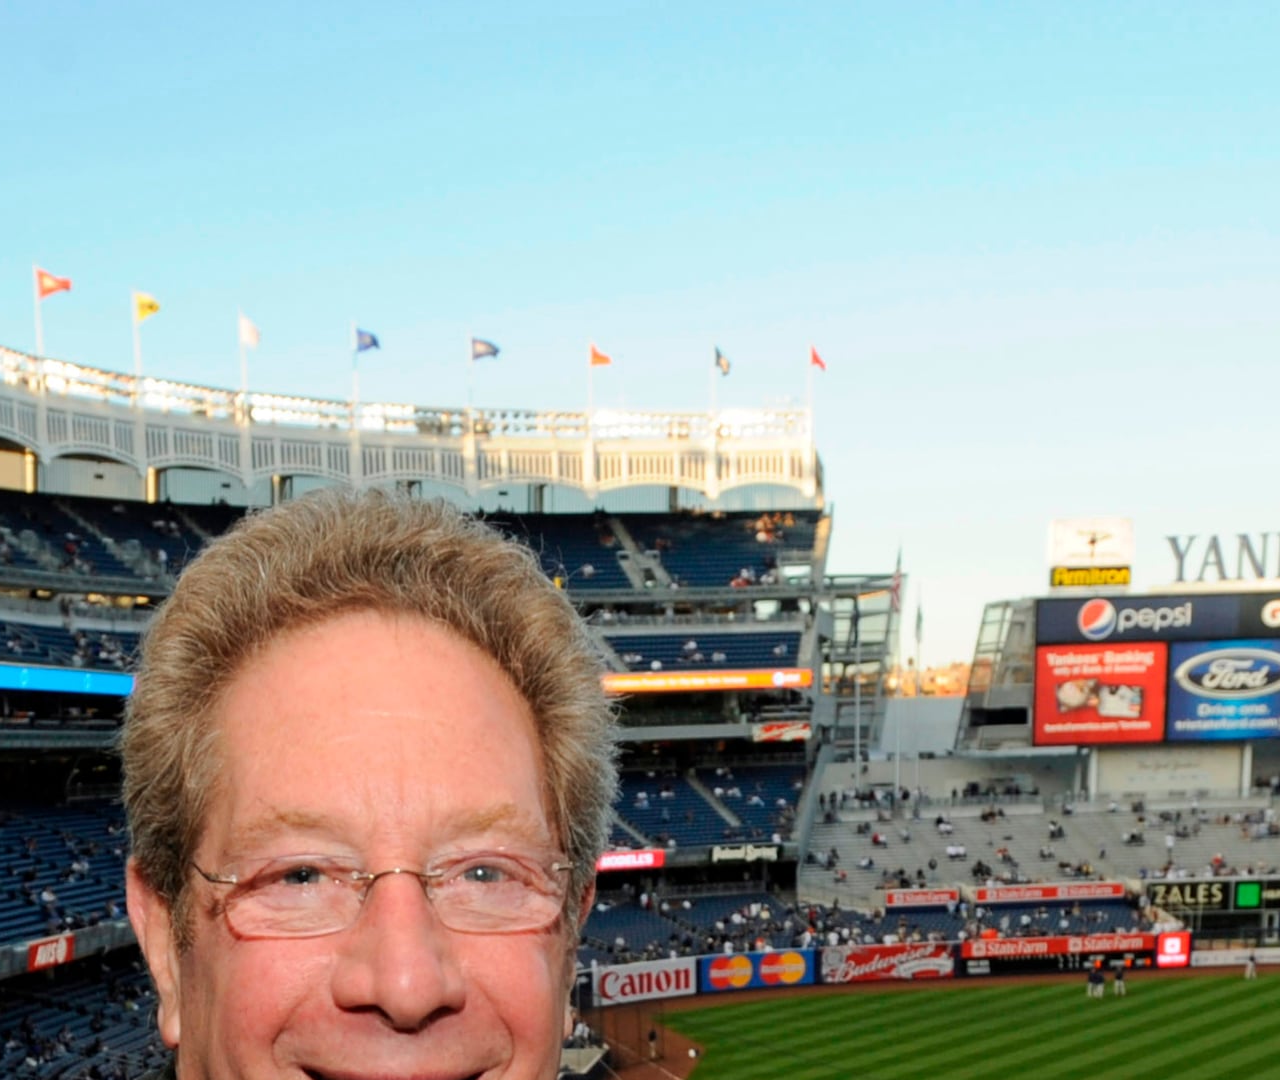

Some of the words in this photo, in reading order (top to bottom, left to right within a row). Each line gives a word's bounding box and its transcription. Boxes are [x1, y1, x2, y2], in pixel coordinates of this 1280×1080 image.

[1053, 567, 1131, 586] Armitron
[1117, 602, 1193, 633] pepsi
[1202, 659, 1269, 690] Ford
[1153, 883, 1223, 905] ZALES
[836, 942, 936, 983] Budweiser
[598, 967, 691, 1000] Canon
